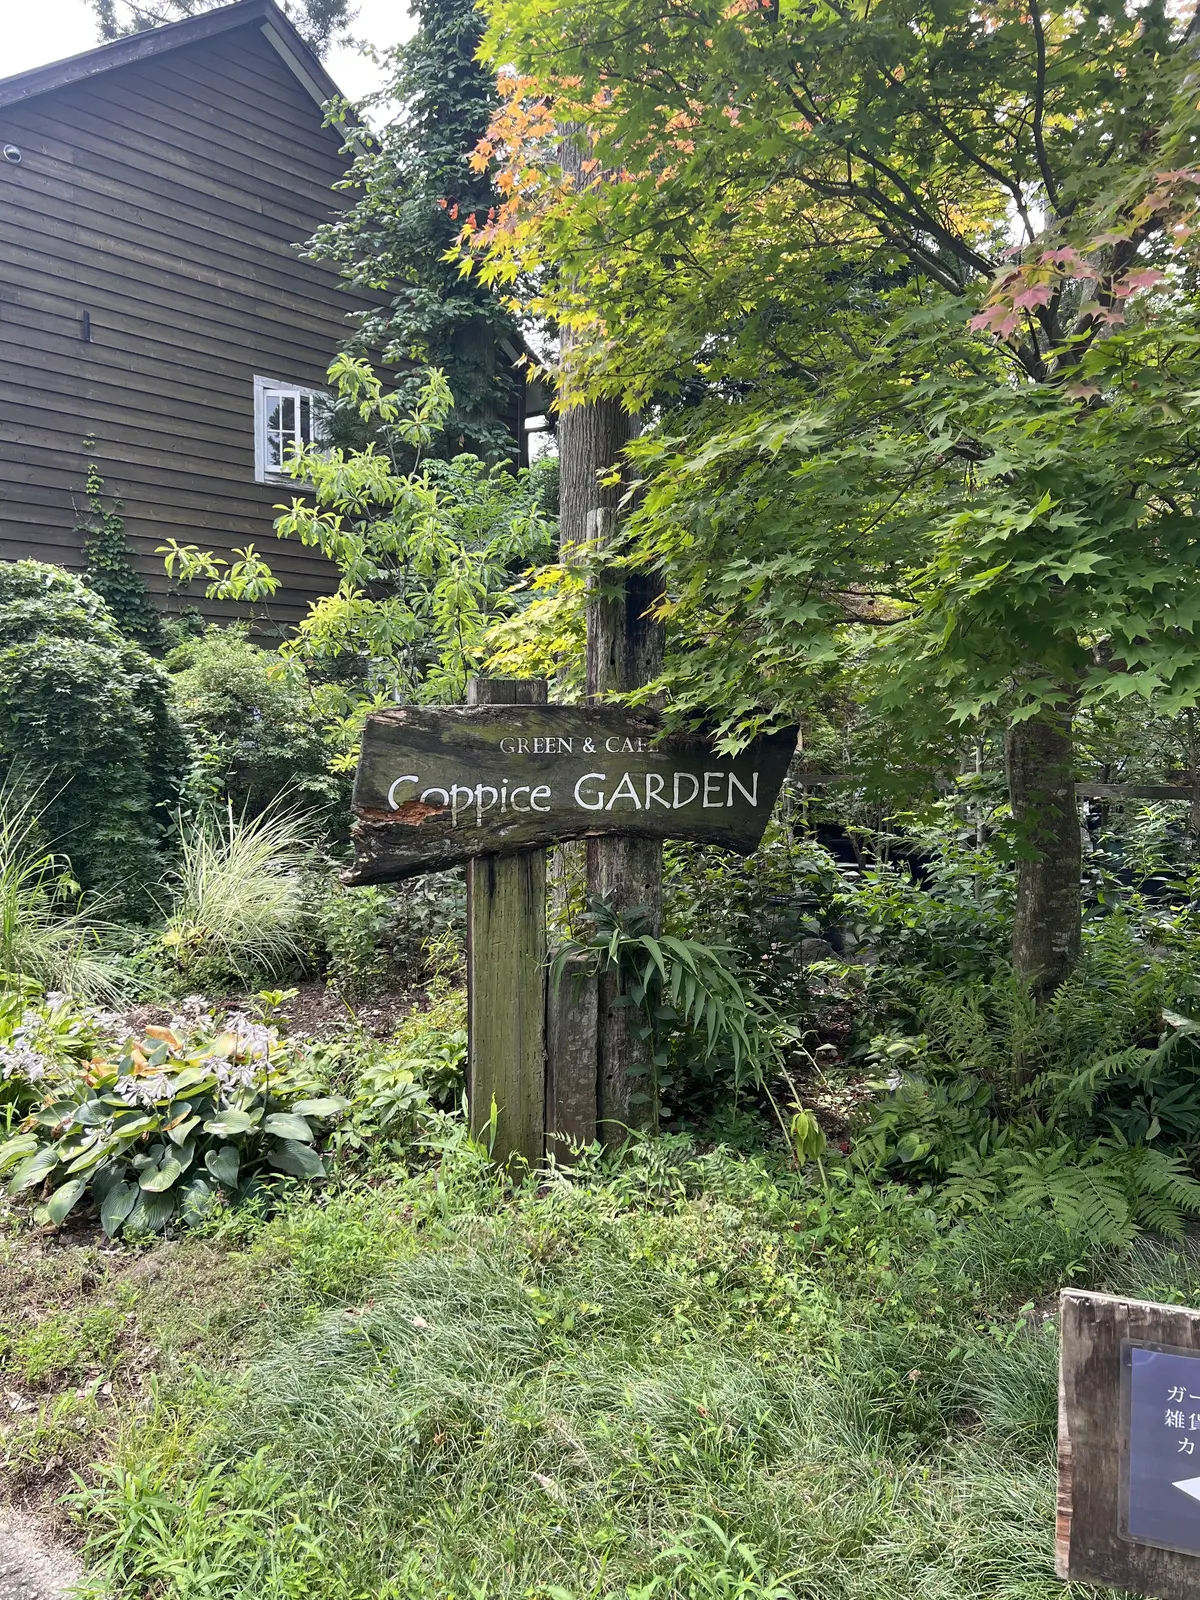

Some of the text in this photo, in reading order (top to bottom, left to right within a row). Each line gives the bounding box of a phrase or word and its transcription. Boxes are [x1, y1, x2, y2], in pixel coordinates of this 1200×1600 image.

[500, 736, 573, 754] GREEN
[582, 736, 597, 754] &
[387, 771, 759, 827] Coppice GARDEN
